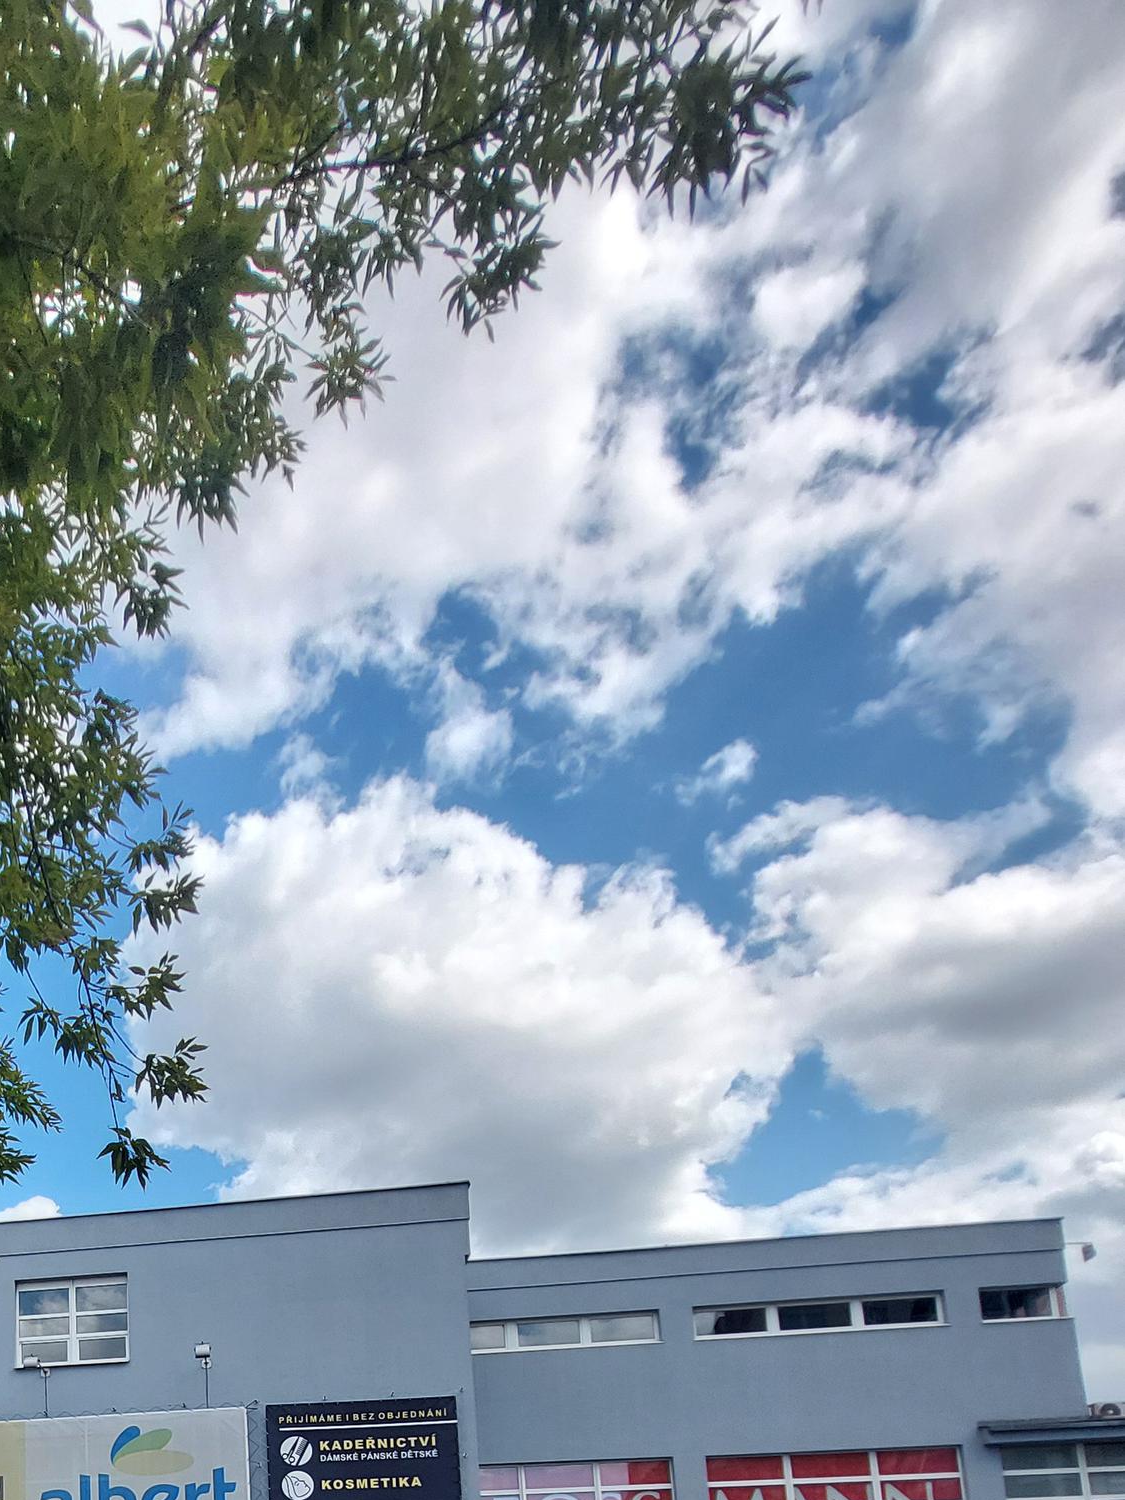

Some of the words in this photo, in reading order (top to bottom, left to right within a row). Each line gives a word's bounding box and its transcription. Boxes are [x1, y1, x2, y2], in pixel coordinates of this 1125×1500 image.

[278, 1412, 342, 1424] PŘIJÍMÁME
[346, 1414, 350, 1422] I
[352, 1412, 375, 1421] BEZ
[378, 1408, 447, 1420] OBJEDNÁNÍ
[319, 1433, 437, 1451] KADEŘNICTVÍ
[320, 1452, 359, 1462] DÁMSKÉ
[361, 1450, 399, 1460] PÁNSKÉ
[401, 1449, 439, 1459] DĚTSKÉ
[321, 1476, 422, 1491] KOSMETIKA
